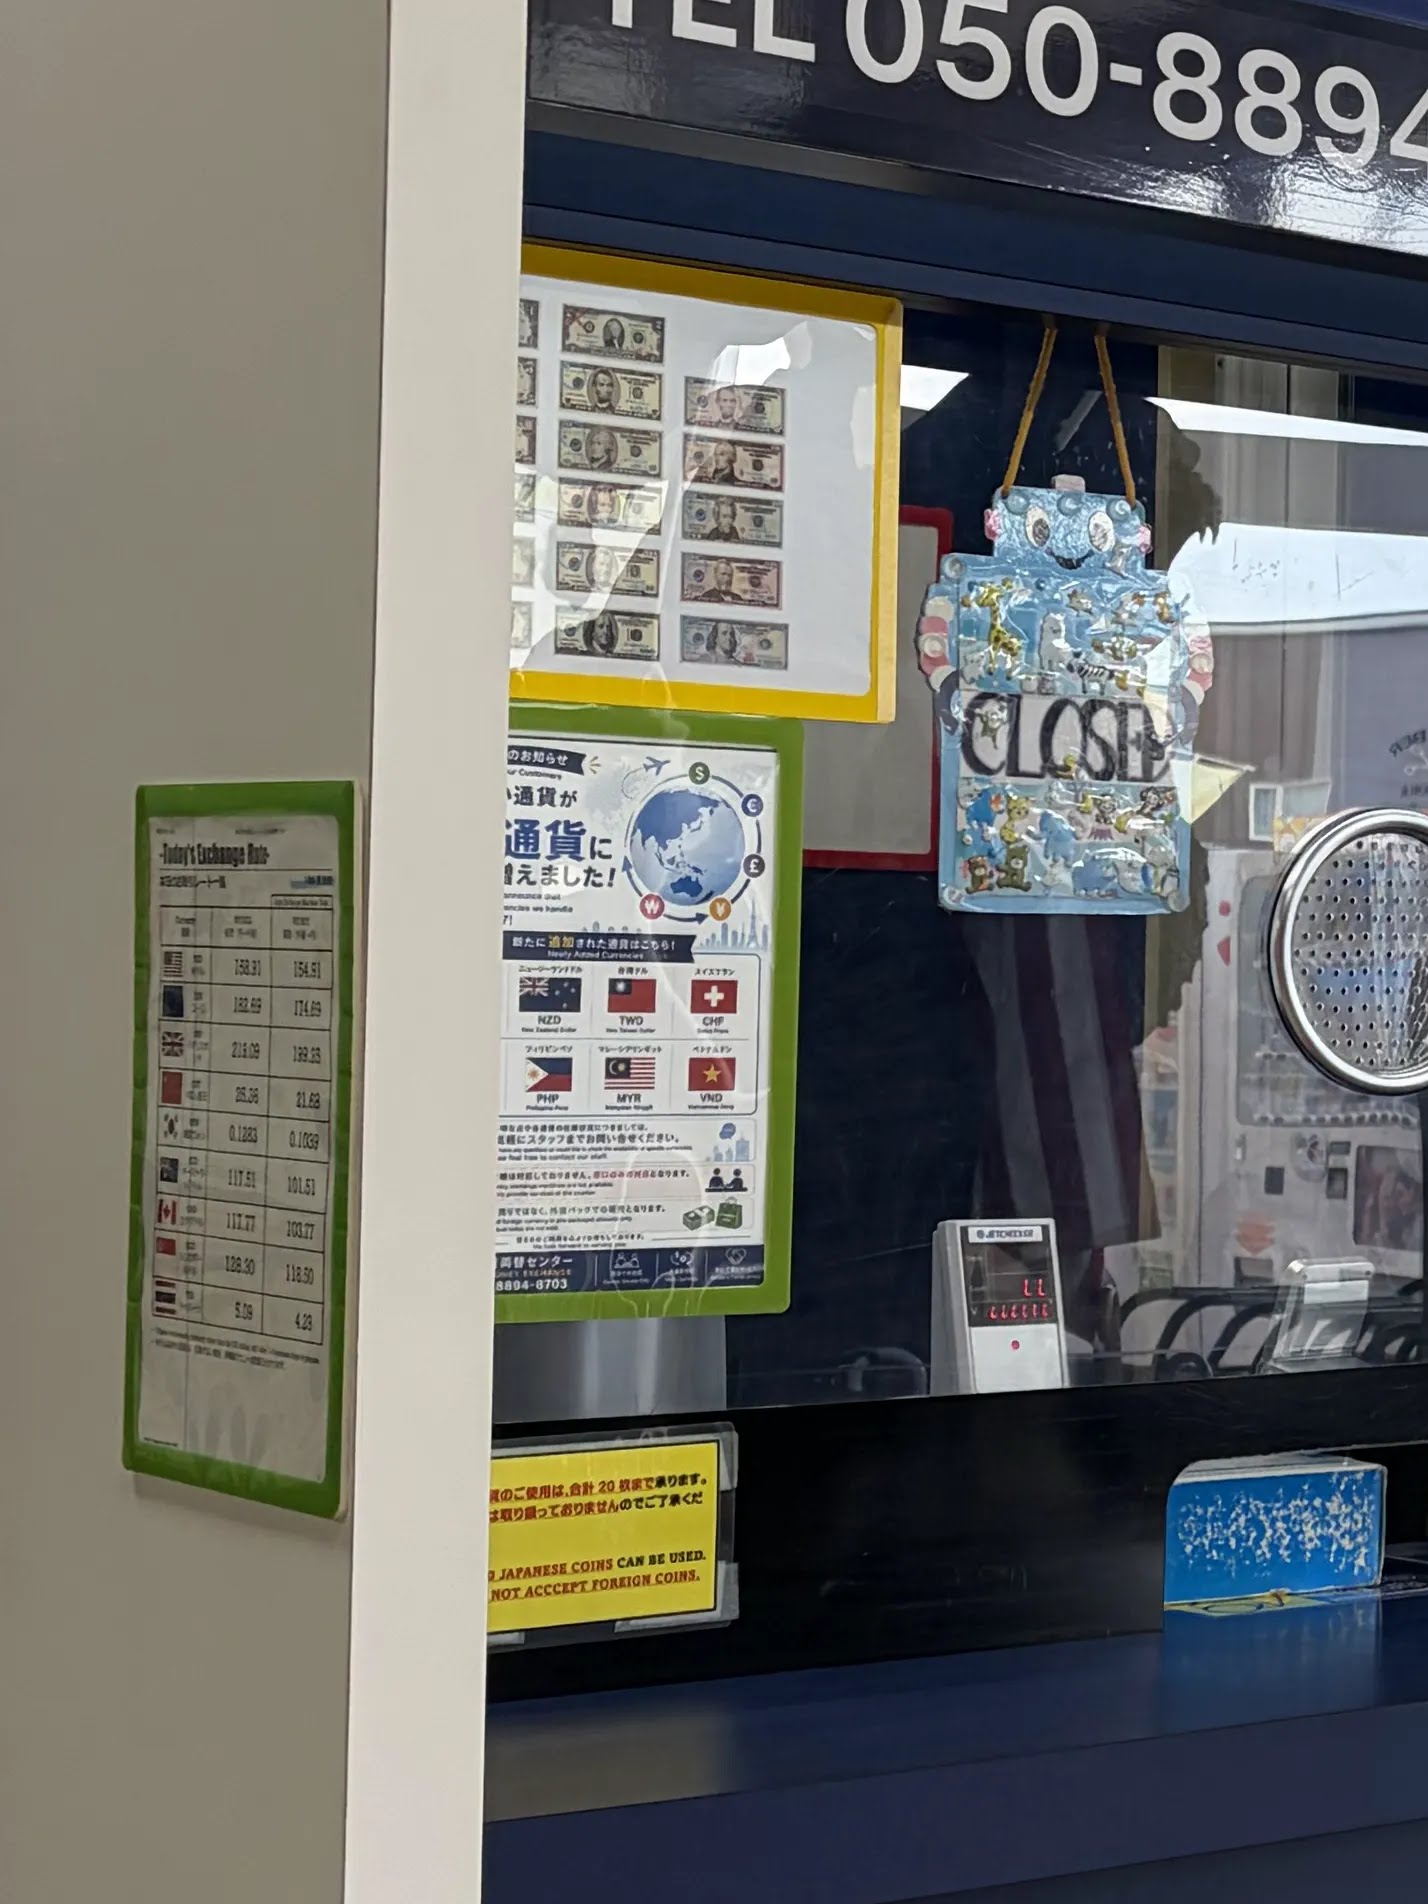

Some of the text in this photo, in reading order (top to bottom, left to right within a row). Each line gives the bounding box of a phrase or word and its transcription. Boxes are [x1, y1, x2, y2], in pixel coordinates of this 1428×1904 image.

[960, 692, 1172, 782] CLOSED
[197, 844, 245, 867] Exchange
[538, 1016, 562, 1026] NZD
[536, 1093, 560, 1104] PHP
[616, 1093, 642, 1104] MYR
[699, 1093, 724, 1103] VND
[598, 1480, 615, 1493] 20
[499, 1562, 567, 1580] JAPANESE
[571, 1557, 613, 1573] COINS
[617, 1554, 644, 1569] CAN
[648, 1553, 665, 1566] BE
[669, 1550, 706, 1564] USED.
[491, 1585, 521, 1602] NOT
[592, 1574, 651, 1593] FOREIGN
[655, 1569, 700, 1588] COINS.
